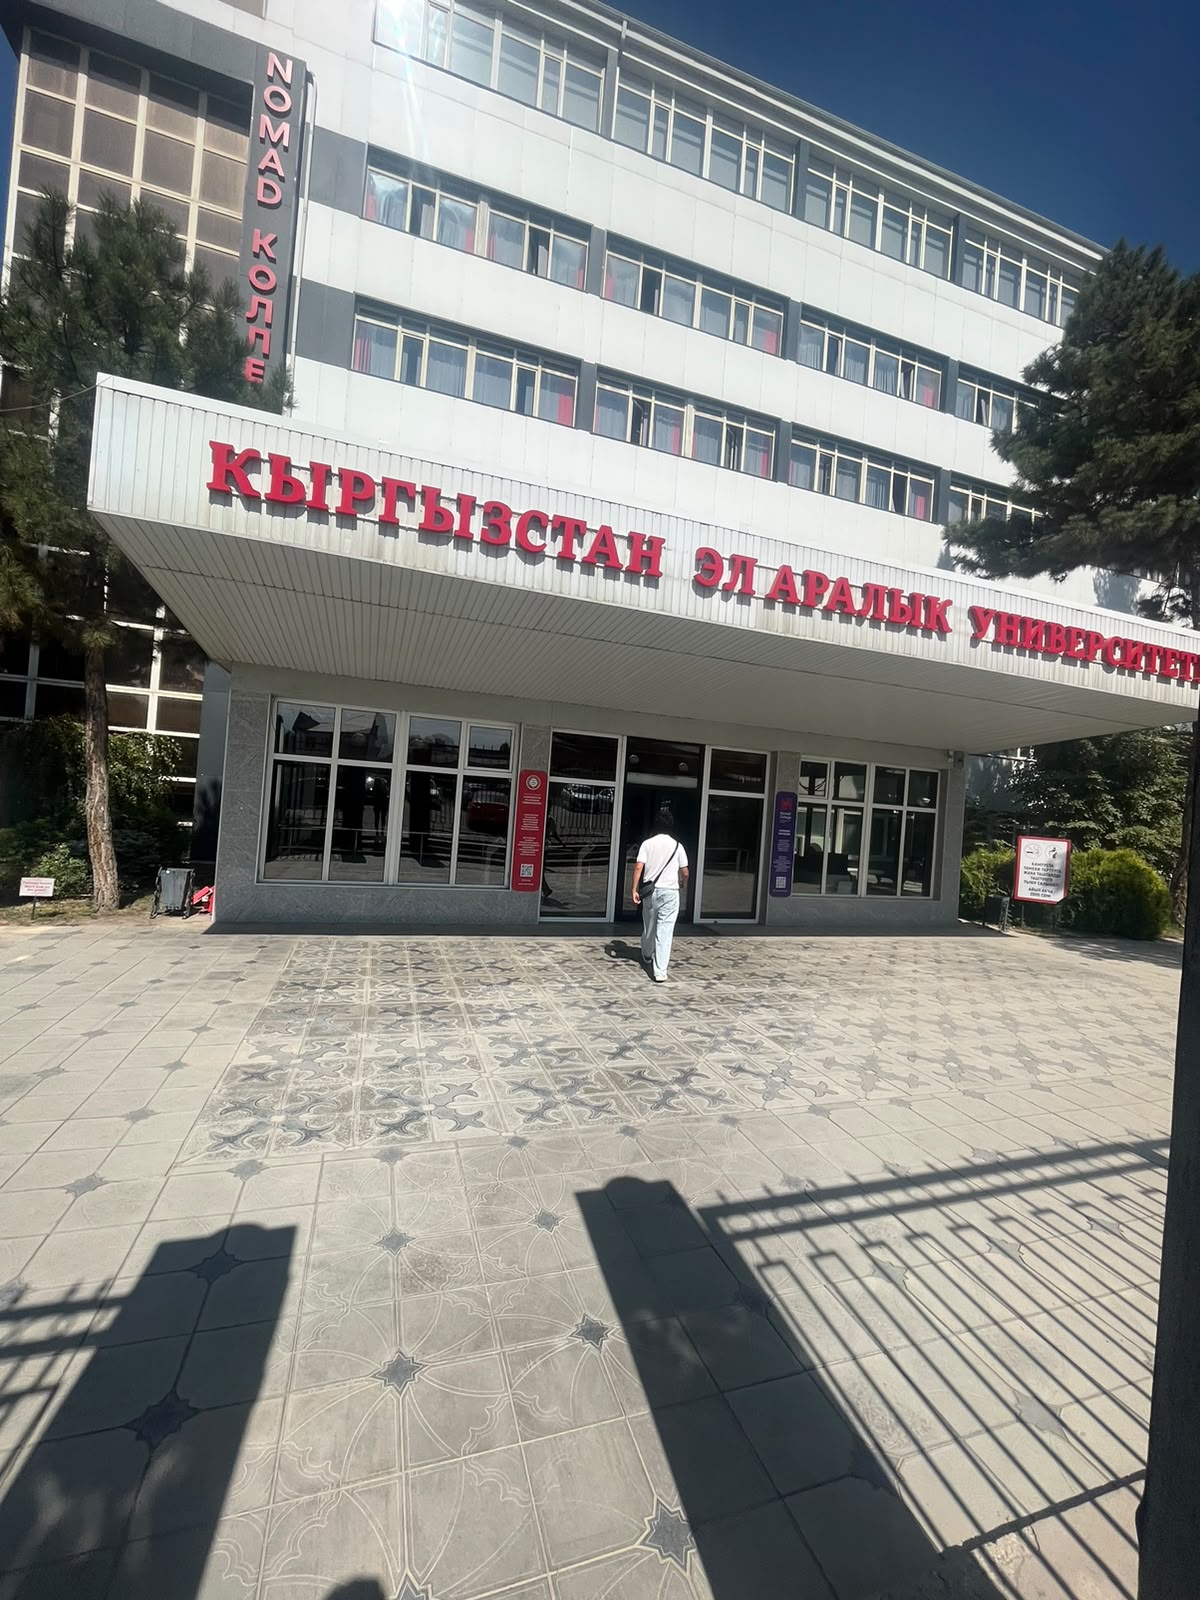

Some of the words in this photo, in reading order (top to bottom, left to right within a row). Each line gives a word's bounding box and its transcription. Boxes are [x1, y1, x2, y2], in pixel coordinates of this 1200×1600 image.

[256, 51, 294, 207] NOMAD
[244, 228, 278, 385] КОЛЛЕ
[206, 440, 666, 578] КЫРГЫЗСТАН
[693, 546, 759, 596] ЭЛ
[764, 564, 953, 633] АРАЛЫК
[968, 605, 1200, 684] УНИВЕРСИТЕТ
